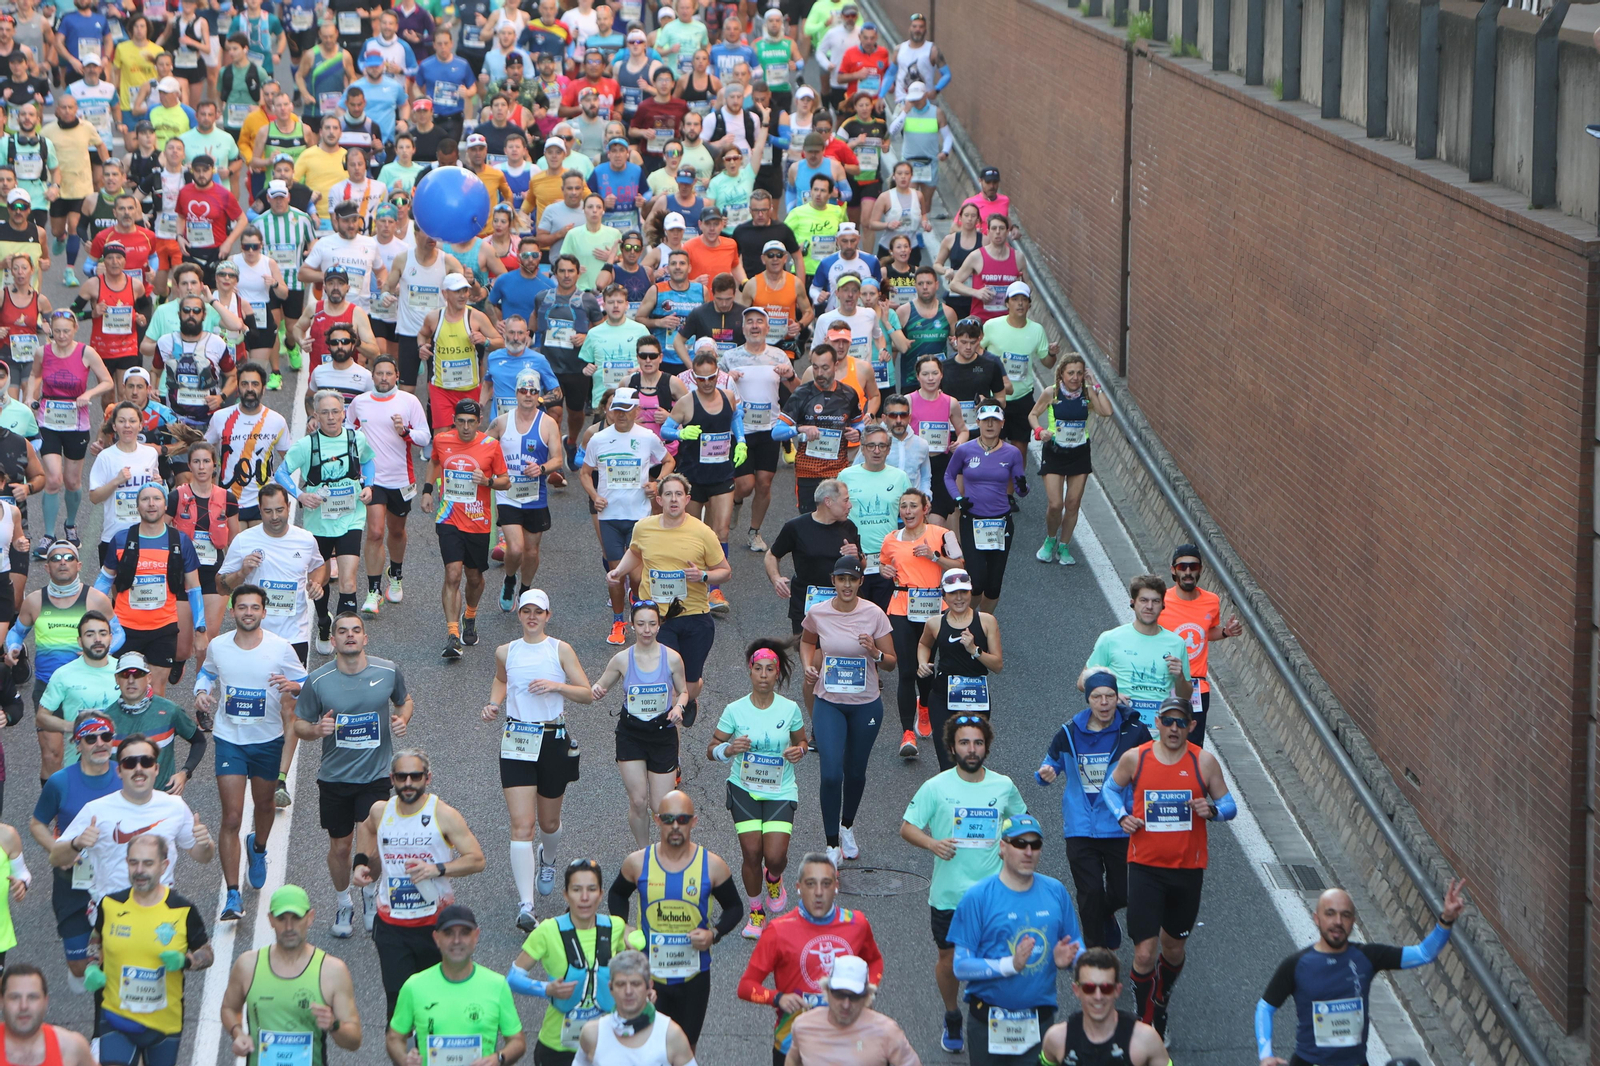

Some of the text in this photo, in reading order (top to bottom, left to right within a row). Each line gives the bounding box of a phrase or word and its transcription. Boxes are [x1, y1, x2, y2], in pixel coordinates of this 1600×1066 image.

[272, 582, 294, 590] ZURICH
[962, 676, 982, 684] ZURICH
[236, 701, 253, 709] 12334
[350, 715, 374, 723] ZURICH
[516, 725, 539, 733] ZURICH
[757, 757, 780, 765] ZURICH
[1160, 793, 1186, 801] ZURICH
[384, 852, 434, 860] GRANADA
[1331, 1002, 1358, 1011] ZURICH
[277, 1035, 307, 1045] ZURICH
[446, 1037, 475, 1046] ZURICH
